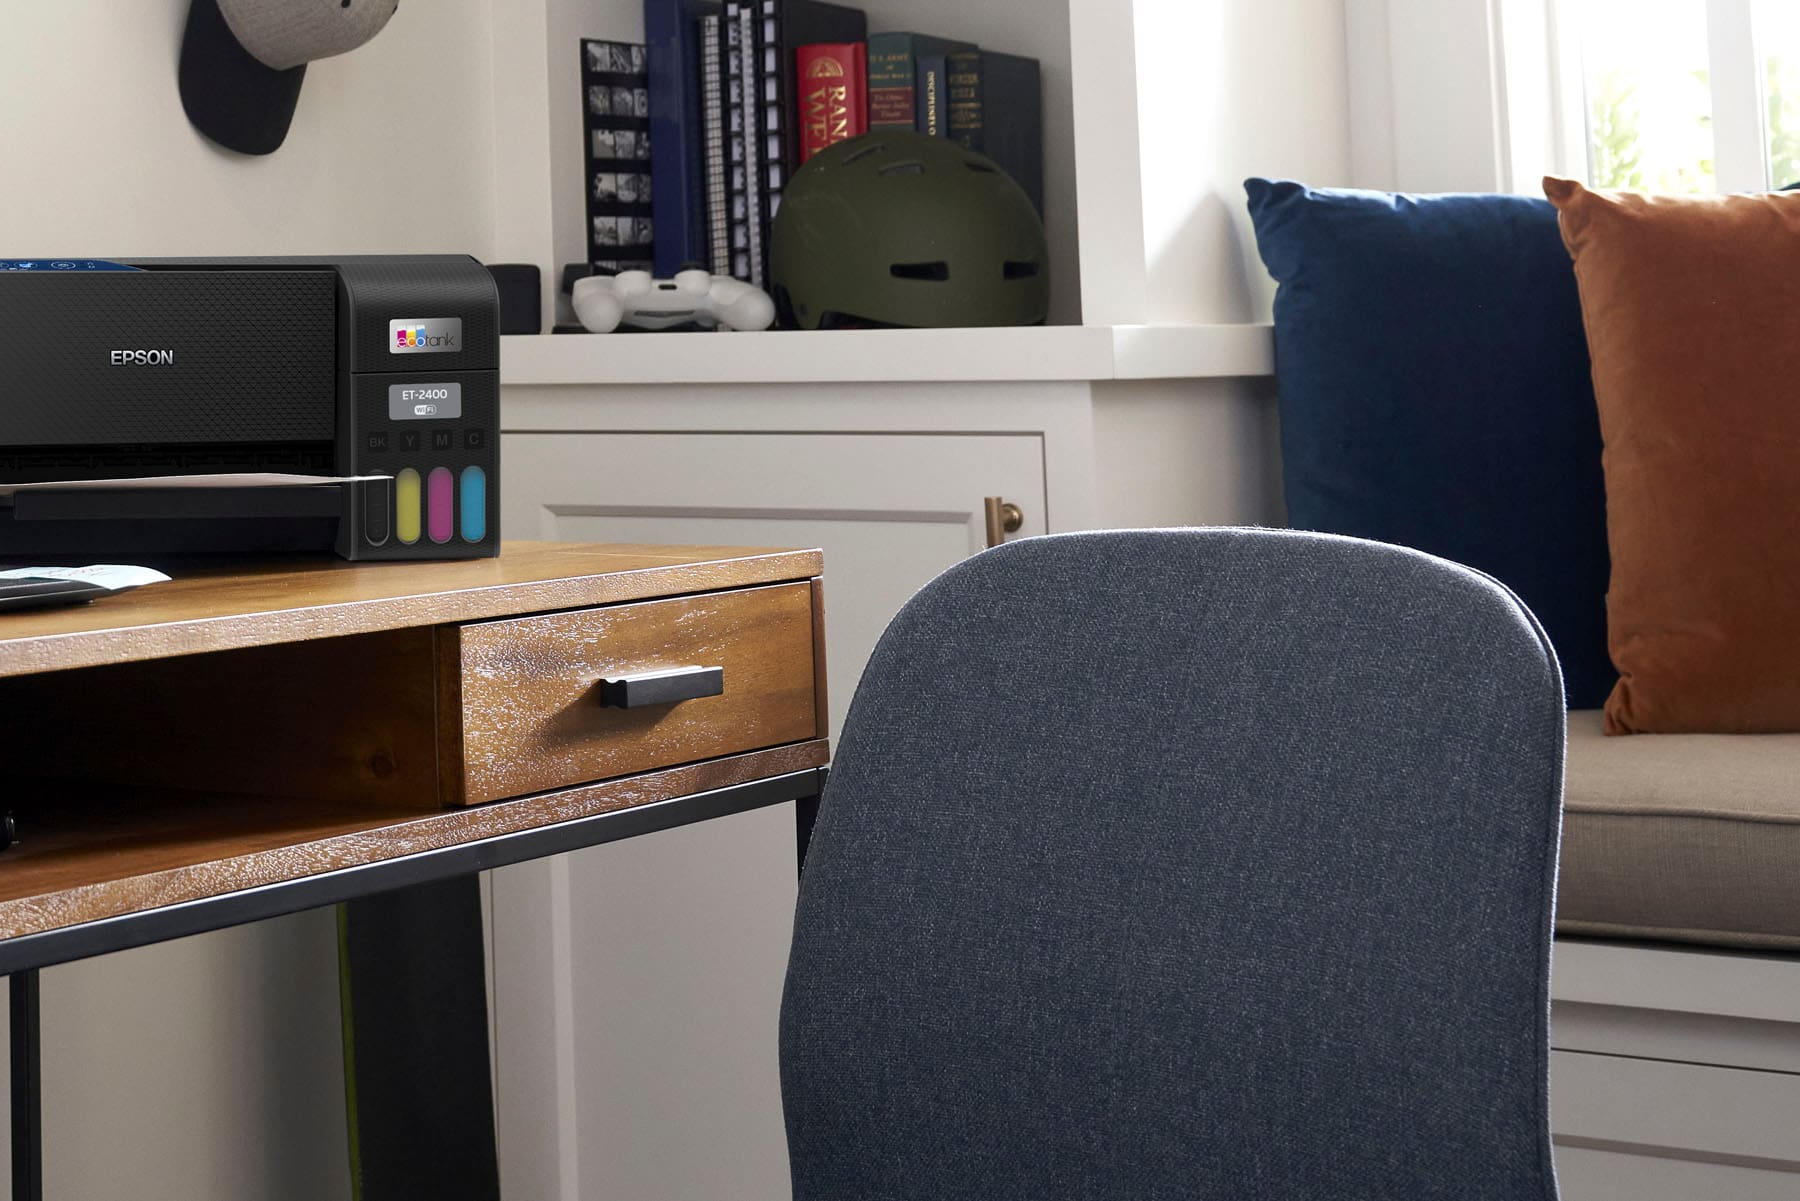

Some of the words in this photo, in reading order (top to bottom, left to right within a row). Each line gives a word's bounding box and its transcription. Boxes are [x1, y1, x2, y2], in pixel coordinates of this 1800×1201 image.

[396, 332, 456, 348] ecotank
[110, 349, 174, 366] EPSON
[402, 388, 448, 400] ET-2400
[369, 437, 387, 448] BK
[405, 435, 415, 448] Y
[436, 434, 449, 446] M
[468, 433, 480, 445] C
